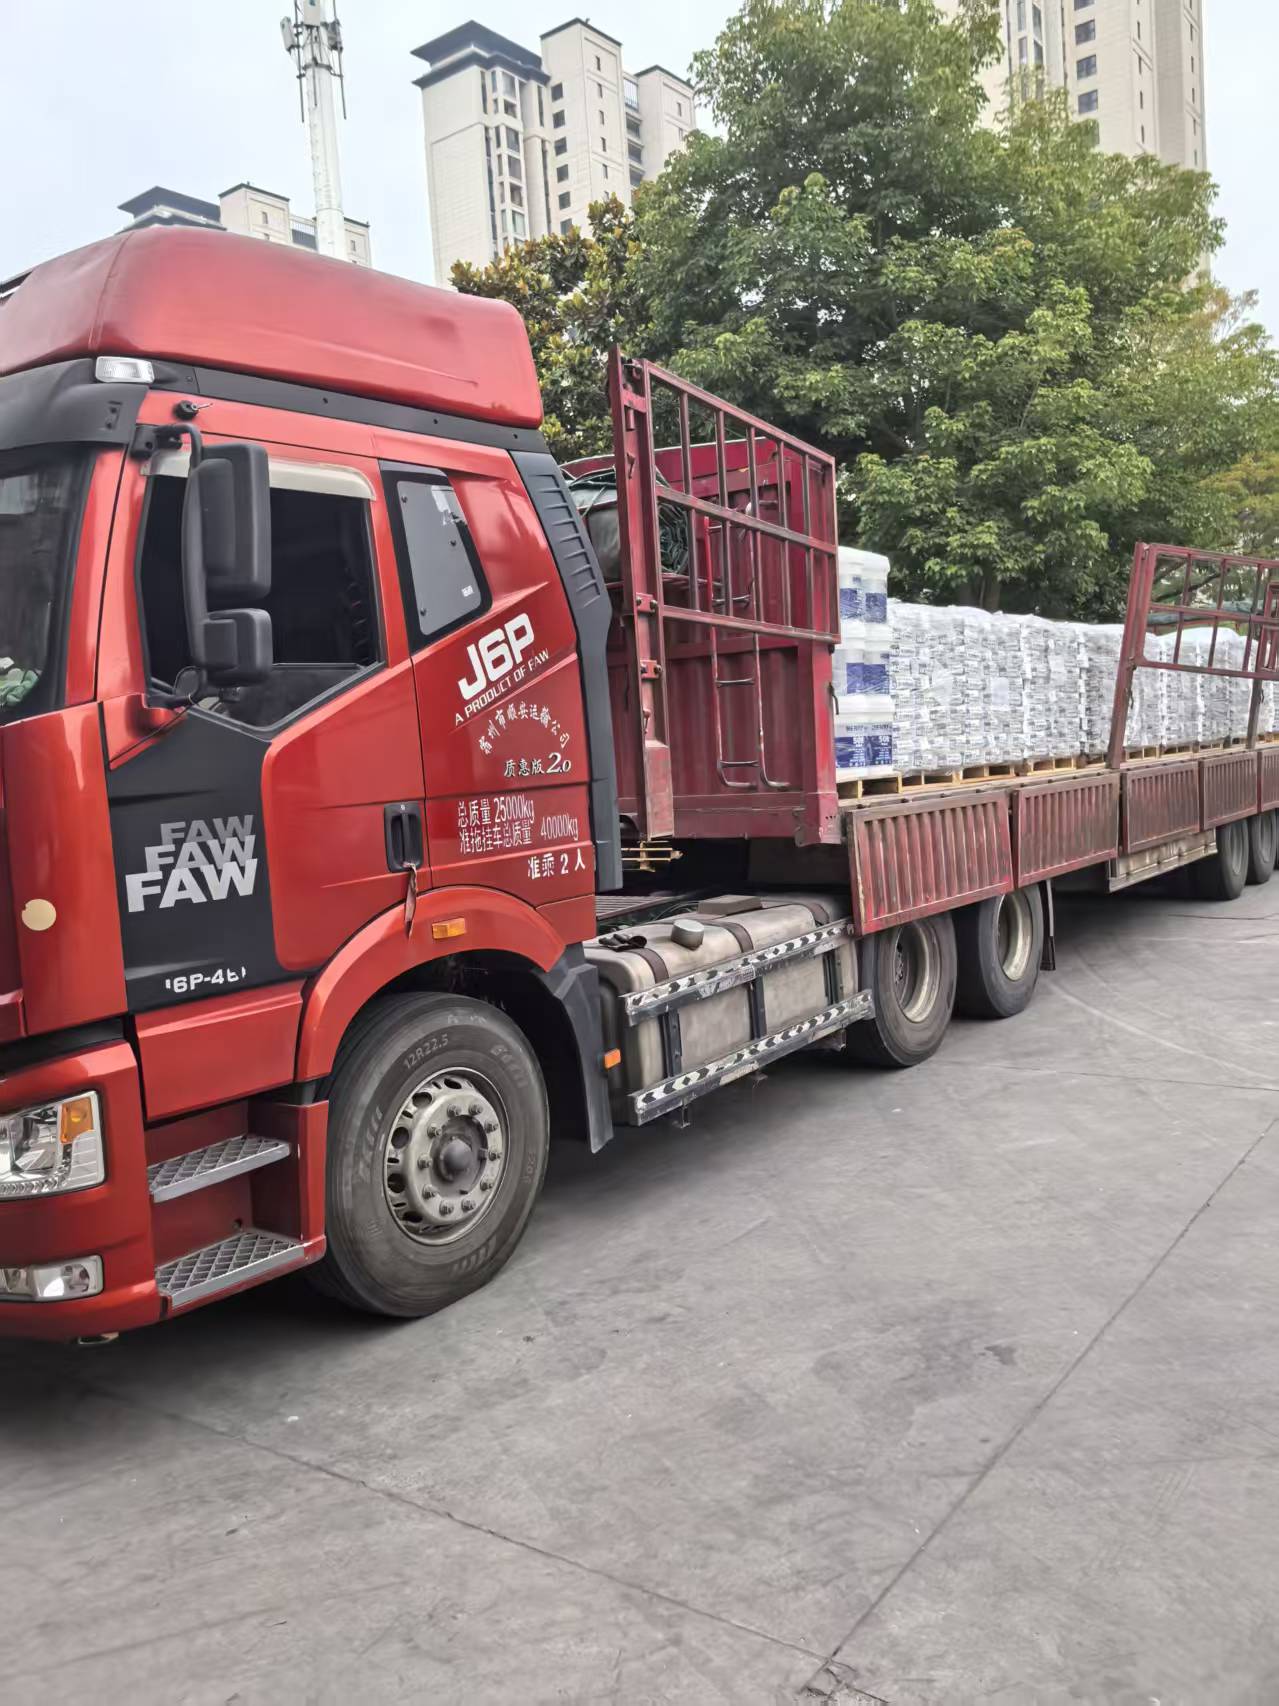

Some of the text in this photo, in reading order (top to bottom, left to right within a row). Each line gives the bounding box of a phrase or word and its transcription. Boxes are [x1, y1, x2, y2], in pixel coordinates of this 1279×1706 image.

[457, 612, 535, 700] J6P
[454, 648, 550, 726] A PRODUCT OF FAW
[493, 792, 535, 824] 25000kg
[160, 814, 254, 846] FAW
[540, 813, 579, 841] 40000kg
[144, 834, 256, 873] FAW
[125, 858, 258, 913] FAW
[403, 1033, 449, 1069] 12R22.5
